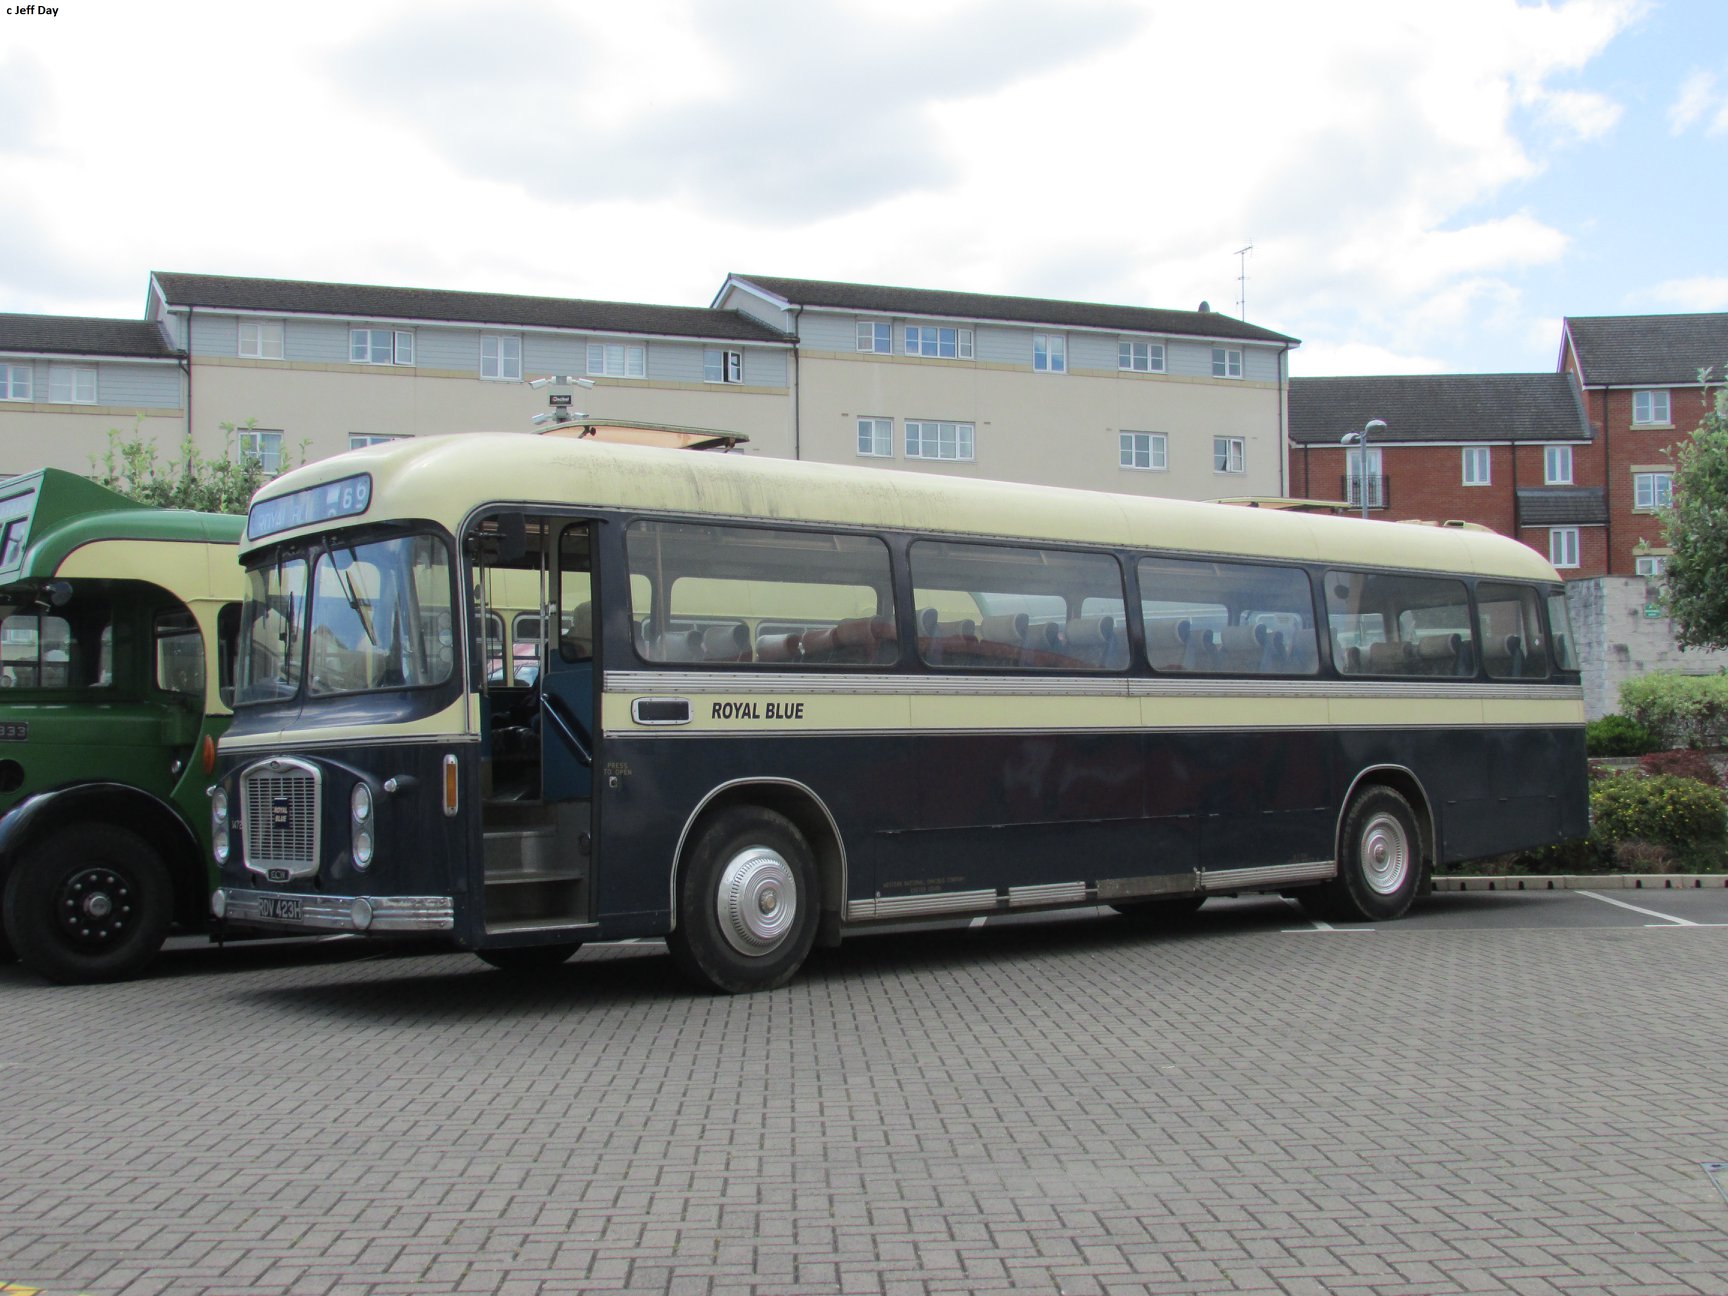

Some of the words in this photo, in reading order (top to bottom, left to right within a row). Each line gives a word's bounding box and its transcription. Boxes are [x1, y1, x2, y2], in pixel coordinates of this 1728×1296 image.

[711, 702, 761, 719] ROYAL
[765, 702, 804, 719] BLUE
[603, 768, 612, 776] TO
[615, 768, 632, 776] OPEN
[273, 806, 288, 814] ROYAL
[275, 815, 287, 823] BLUE
[258, 899, 274, 917] RDV
[276, 901, 301, 919] 423H
